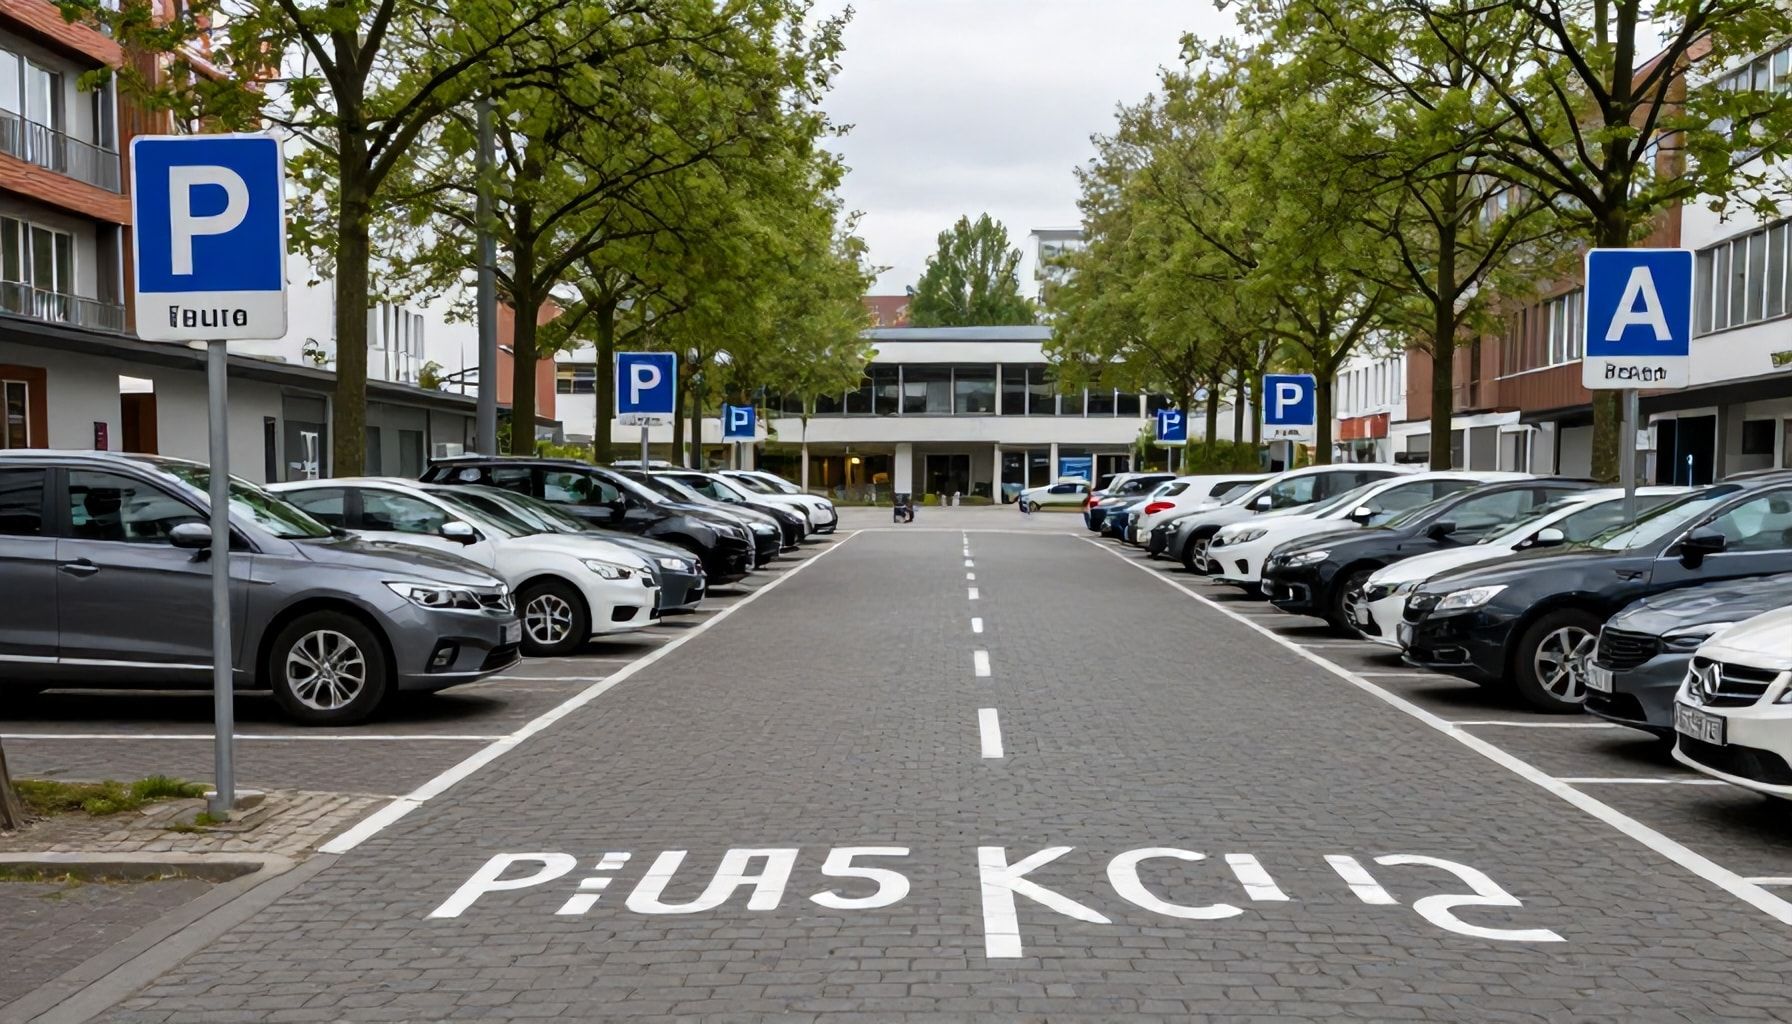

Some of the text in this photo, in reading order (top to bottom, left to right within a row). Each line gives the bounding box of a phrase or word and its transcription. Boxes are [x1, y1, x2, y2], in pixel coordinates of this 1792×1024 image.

[169, 165, 250, 275] P
[1605, 265, 1673, 341] A
[630, 363, 662, 405] P
[1275, 382, 1304, 420] P
[730, 405, 749, 432] P
